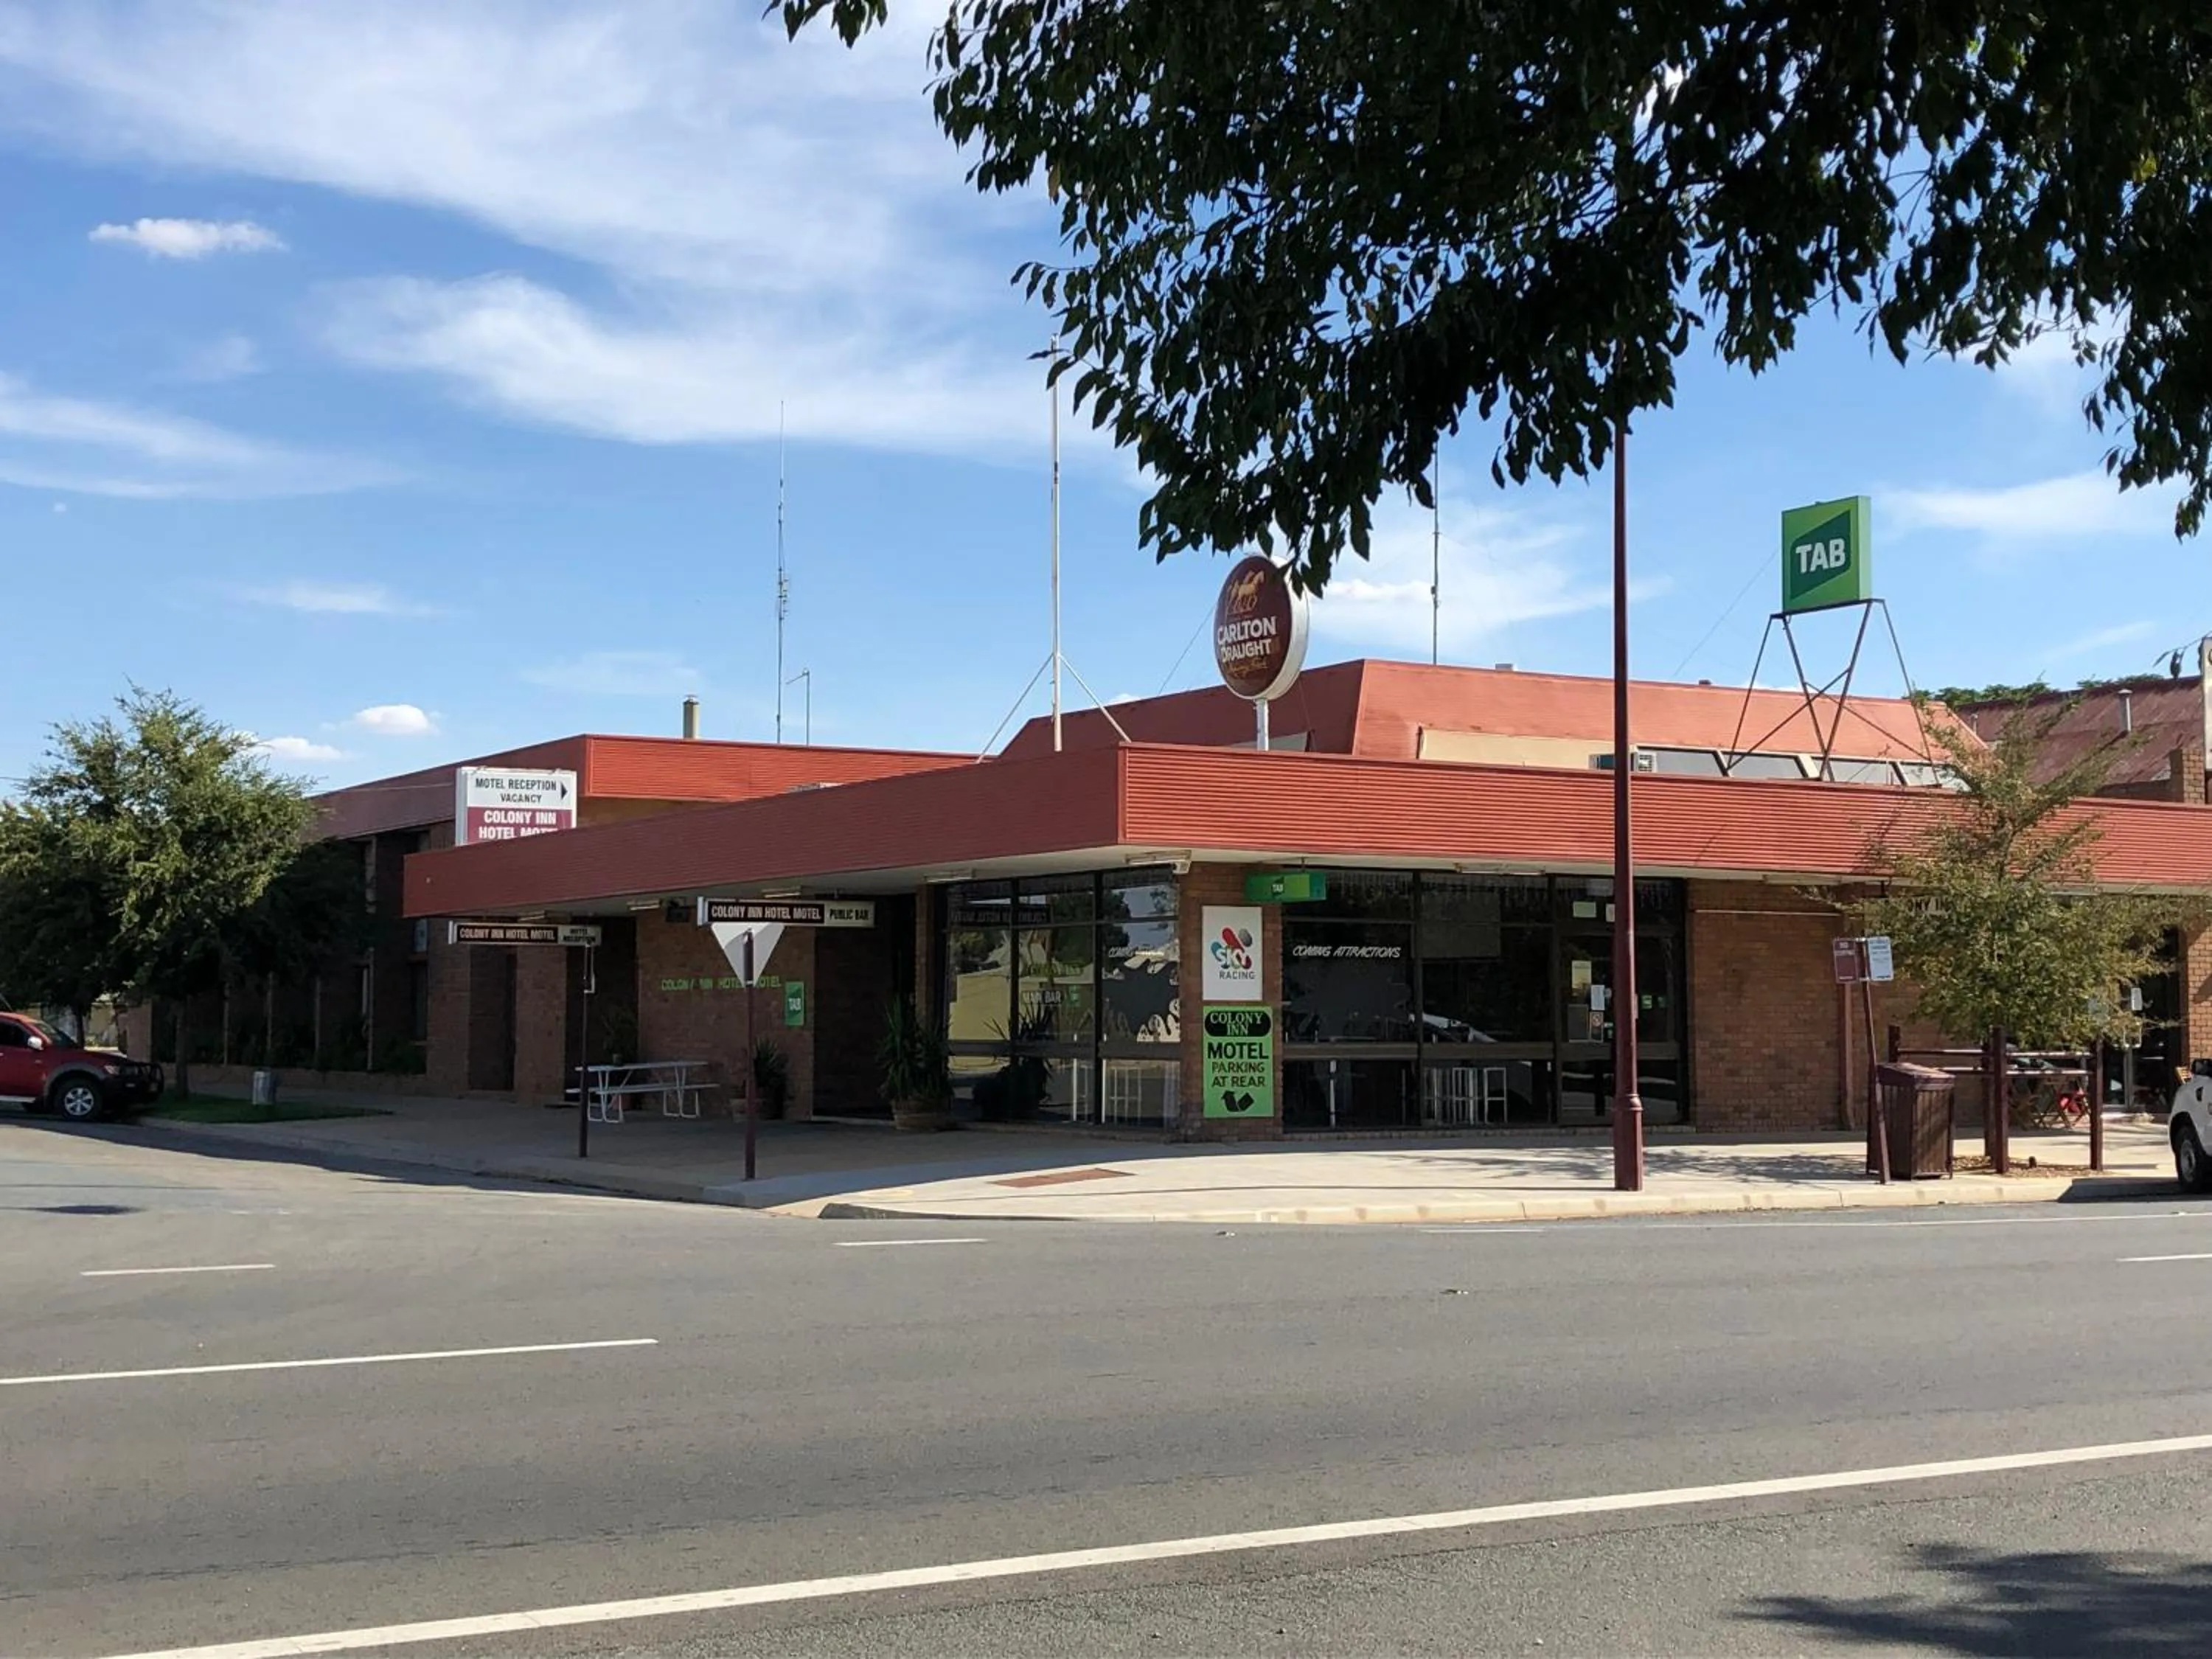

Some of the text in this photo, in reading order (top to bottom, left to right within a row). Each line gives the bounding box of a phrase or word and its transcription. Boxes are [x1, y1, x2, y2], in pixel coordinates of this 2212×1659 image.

[1795, 538, 1846, 574] TAB
[1217, 616, 1277, 644] CARLTON
[1220, 639, 1272, 663] DRAUGHT
[476, 778, 557, 790] MOTEL RECEPTION
[501, 793, 542, 803] VACANCY
[484, 810, 557, 824] COLONY INN
[479, 827, 516, 839] HOTEL
[711, 905, 745, 918] COLONY
[747, 905, 762, 918] INN
[765, 906, 791, 919] HOTEL
[793, 908, 821, 919] MOTEL
[830, 908, 854, 920] PUBLIC
[459, 928, 490, 939] COLONY
[506, 928, 529, 939] HOTEL
[530, 929, 555, 940] MOTEL
[1293, 945, 1402, 958] COMING ATTRACTIONS
[1219, 970, 1256, 980] RACING
[788, 998, 801, 1011] TAB
[1210, 1012, 1263, 1024] COLONY
[1226, 1023, 1249, 1036] INN
[1208, 1042, 1269, 1059] MOTEL
[1211, 1061, 1265, 1074] PARKING
[1211, 1076, 1266, 1088] AT REAR
